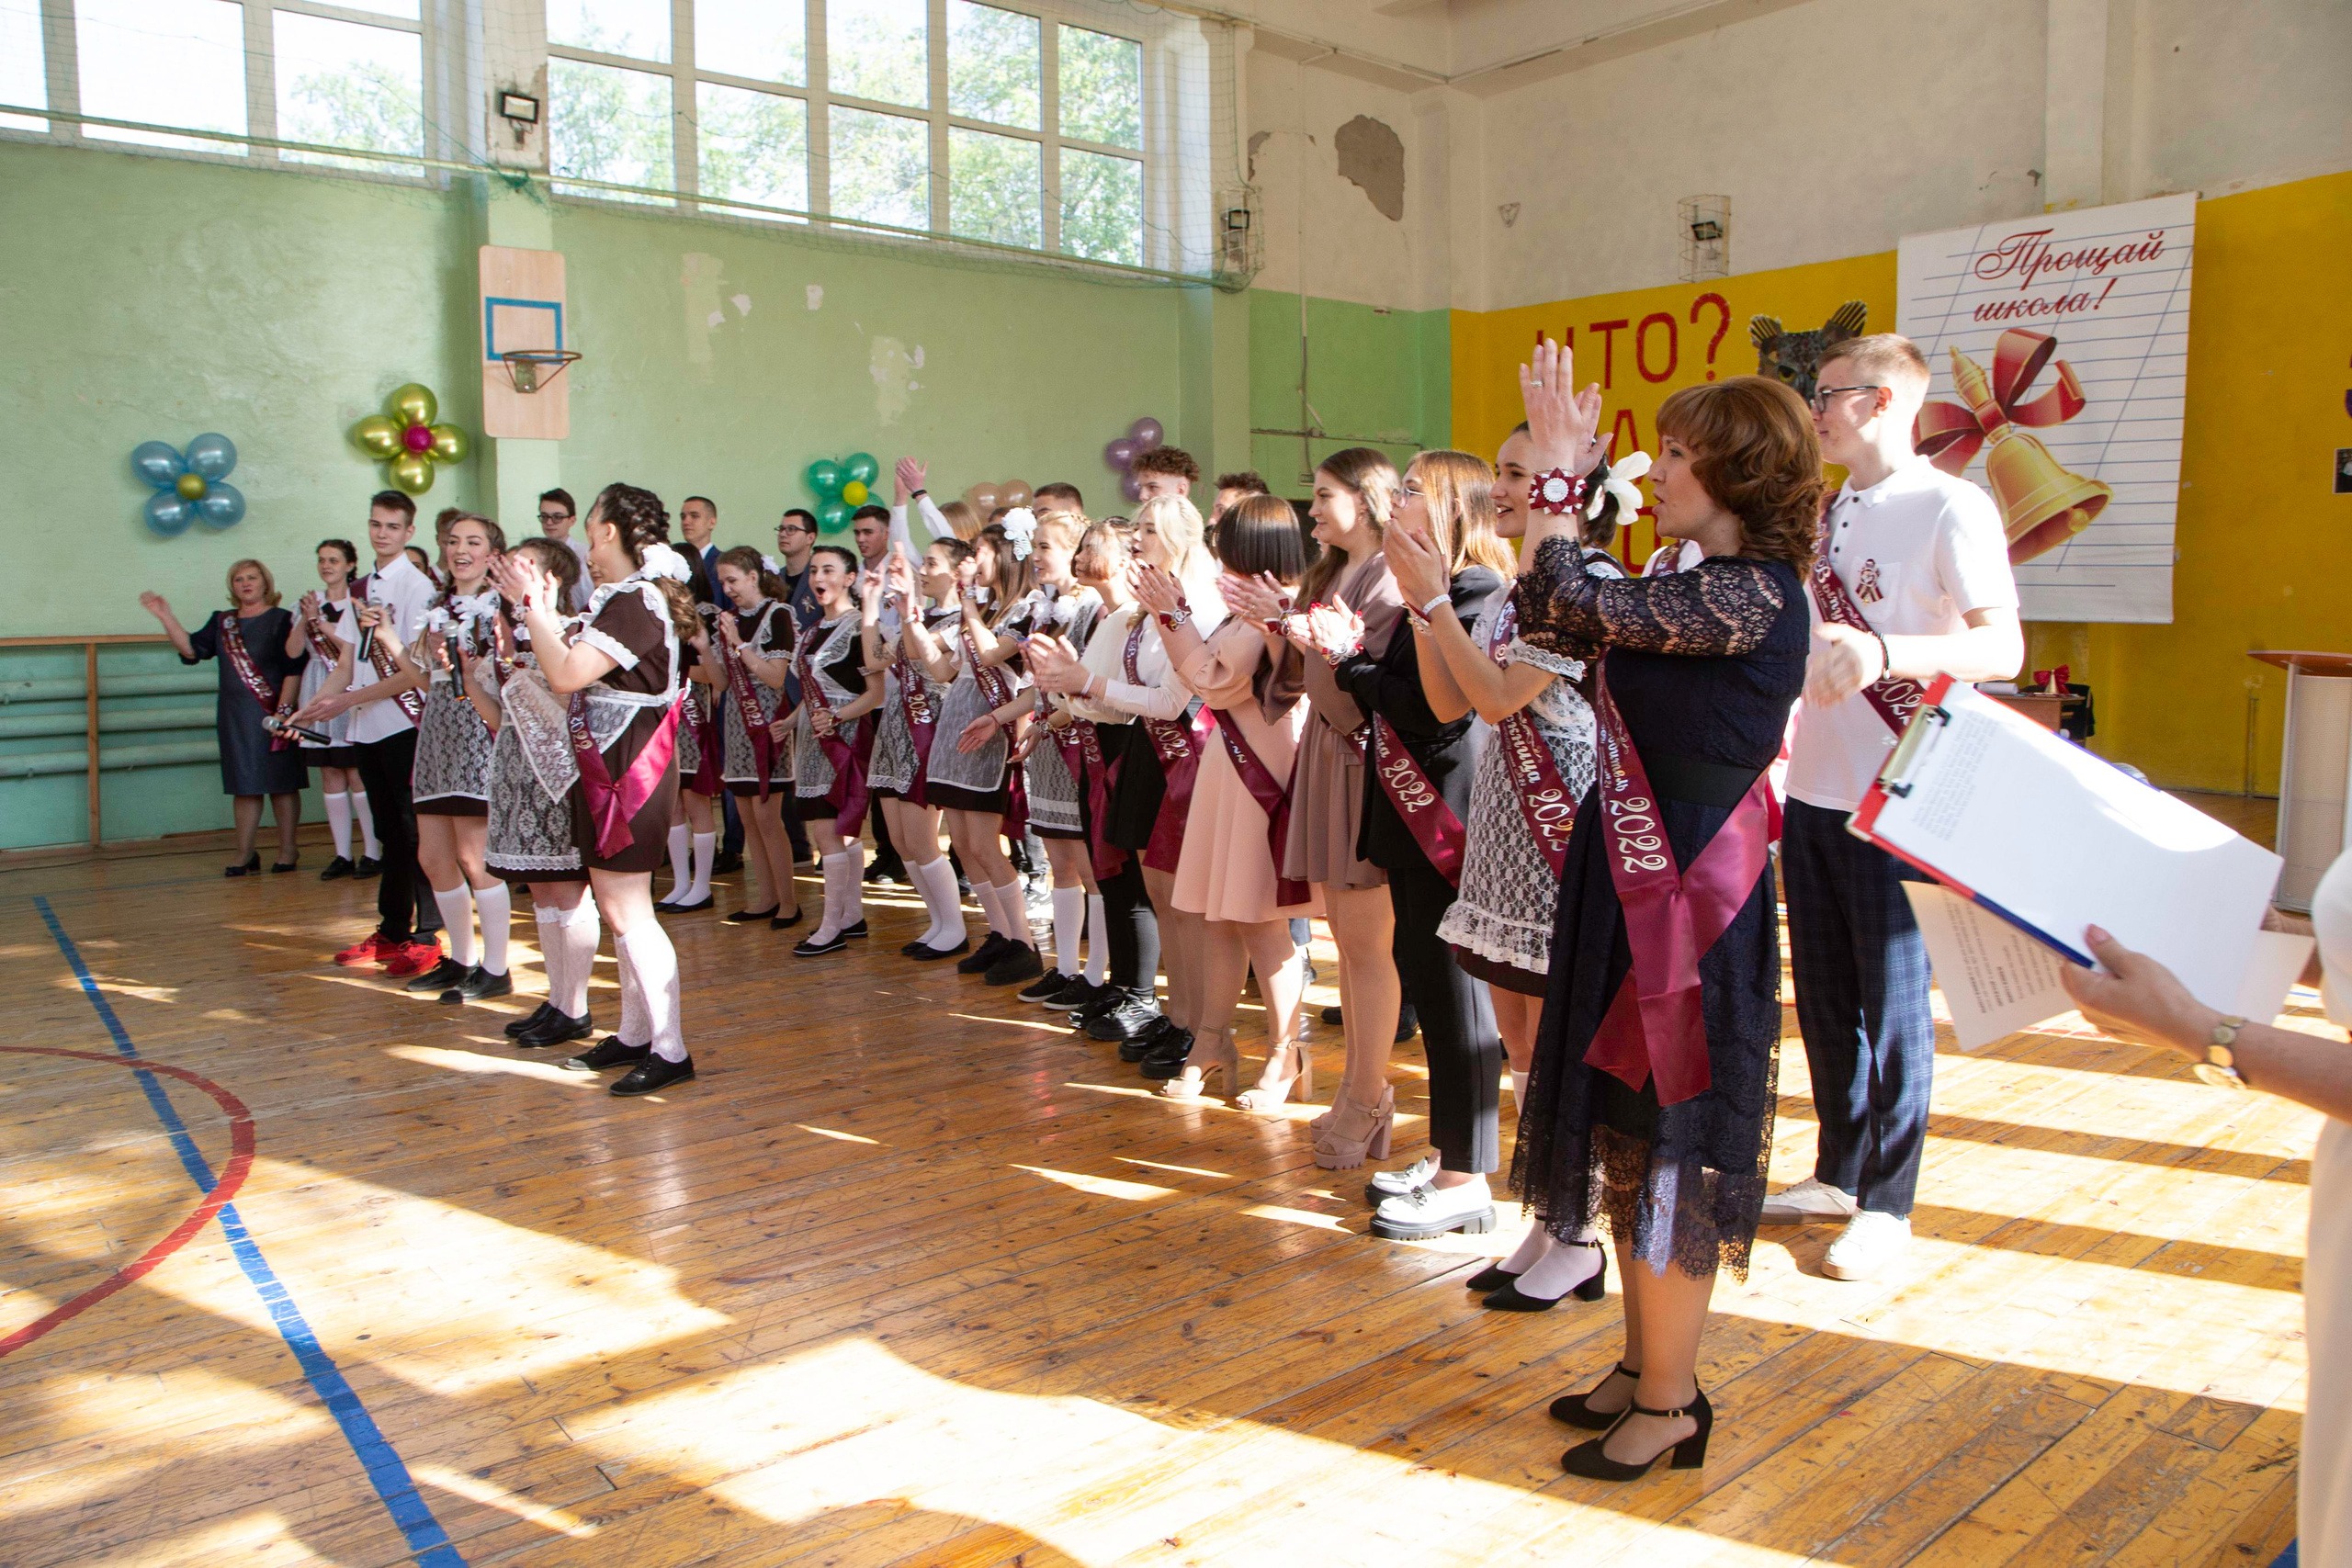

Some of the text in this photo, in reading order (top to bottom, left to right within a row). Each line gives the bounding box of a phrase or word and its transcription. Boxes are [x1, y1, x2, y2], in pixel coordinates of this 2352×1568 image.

[1975, 228, 2165, 291] Прощай
[1973, 277, 2119, 321] школа!
[742, 698, 764, 728] 2022
[908, 694, 933, 725] 2022
[570, 713, 593, 753] 2022
[1080, 726, 1101, 764] 2022
[1153, 721, 1191, 760] 2022
[1382, 758, 1435, 813] 2022
[1610, 796, 1668, 874] 2022
